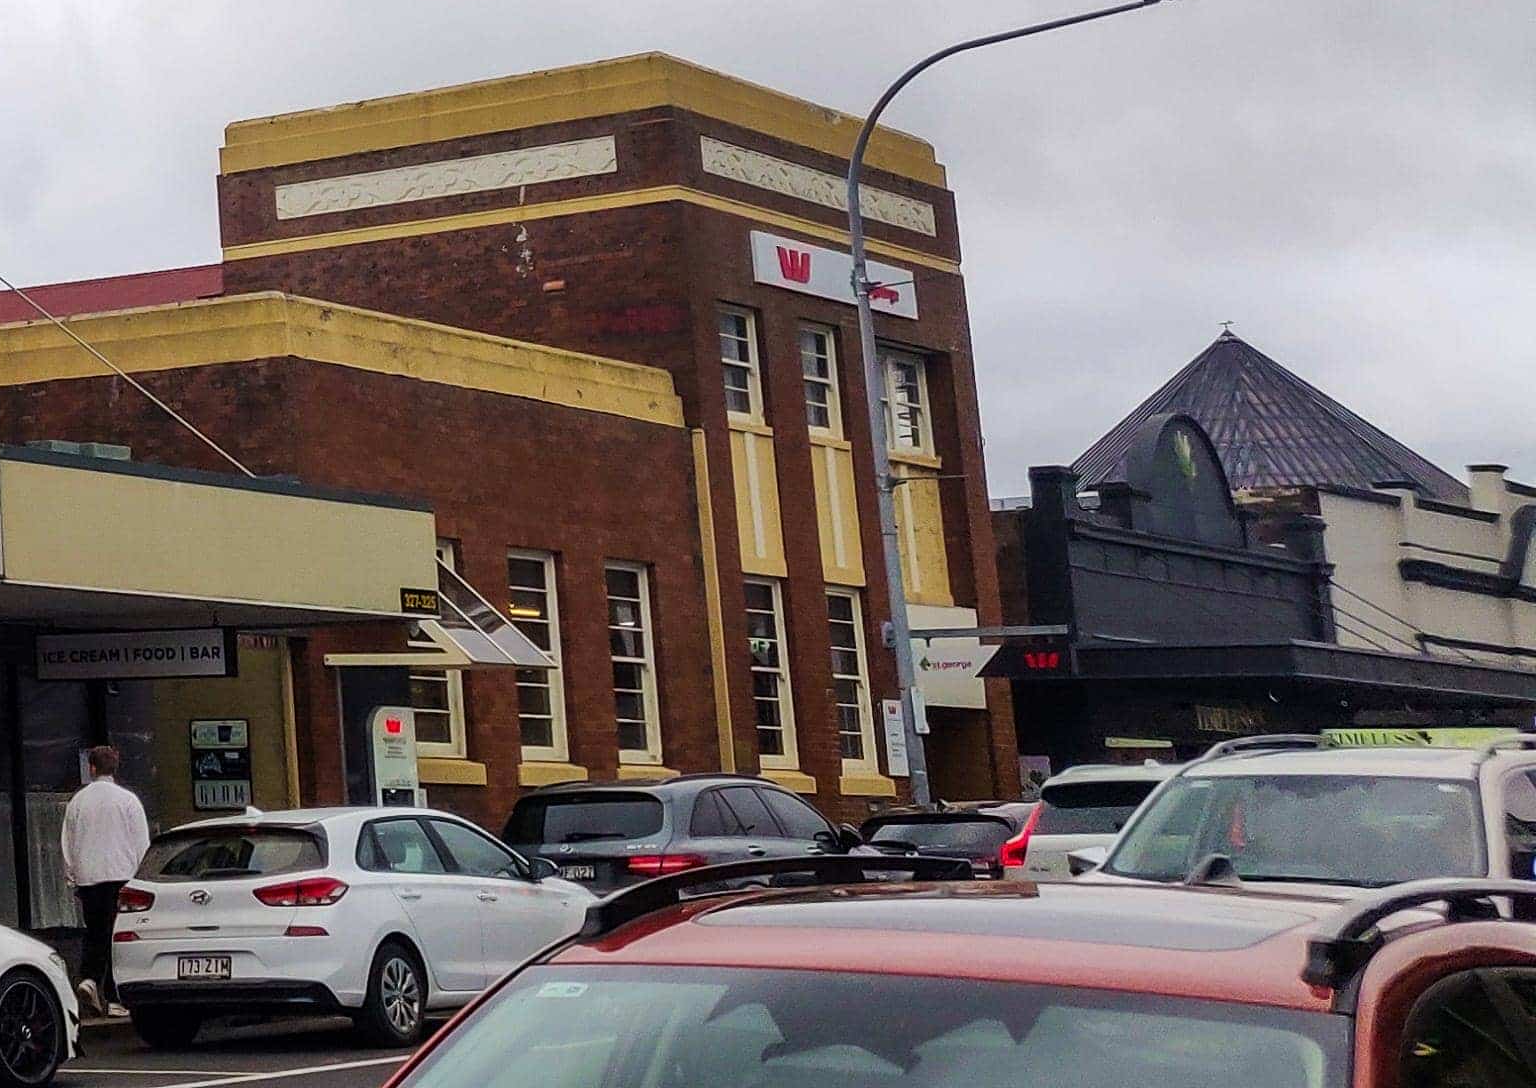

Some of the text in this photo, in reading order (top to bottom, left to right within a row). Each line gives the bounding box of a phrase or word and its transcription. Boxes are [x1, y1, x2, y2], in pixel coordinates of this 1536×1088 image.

[43, 646, 221, 664] ICE CREAM FOOD BAR
